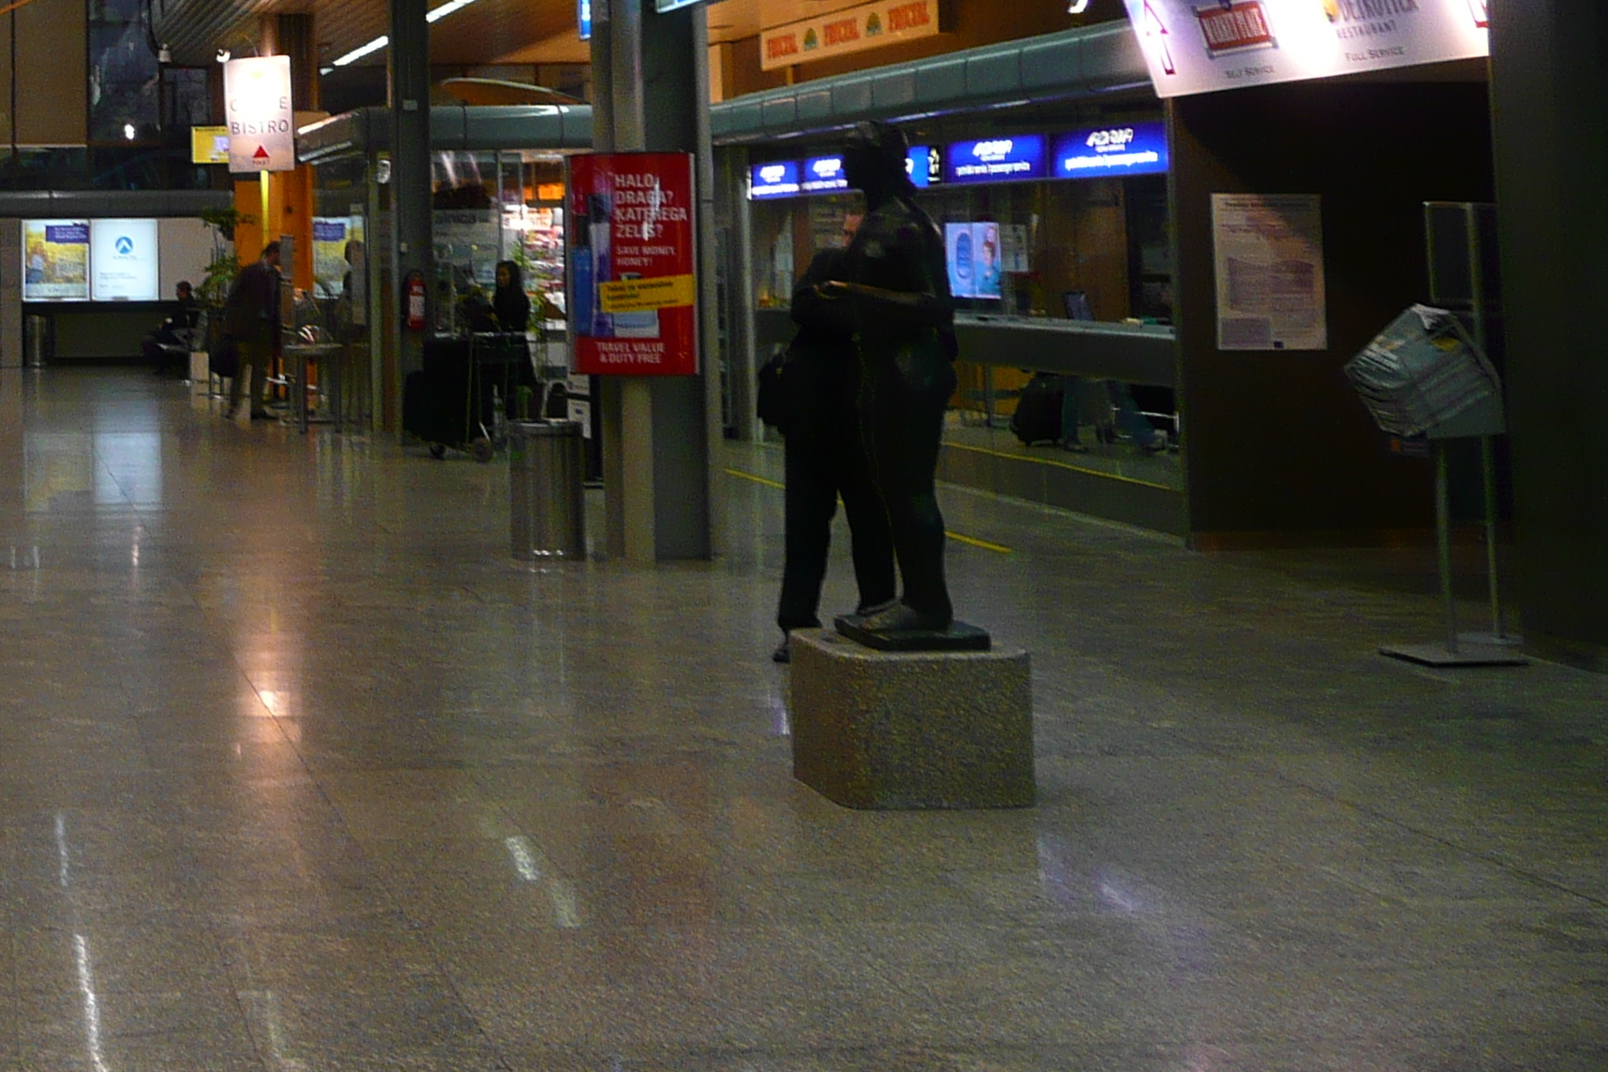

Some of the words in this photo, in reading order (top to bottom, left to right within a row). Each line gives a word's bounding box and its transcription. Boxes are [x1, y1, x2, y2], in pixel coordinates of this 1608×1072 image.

[230, 118, 290, 136] BISTRO
[615, 190, 675, 205] DRAGA?
[615, 206, 688, 222] KATEREGA
[616, 245, 641, 256] SAVE
[616, 256, 653, 268] HONEY!
[596, 340, 630, 354] TRAVEL
[633, 340, 666, 354] VALUE
[607, 352, 635, 365] DUTY
[636, 352, 663, 364] FREE
